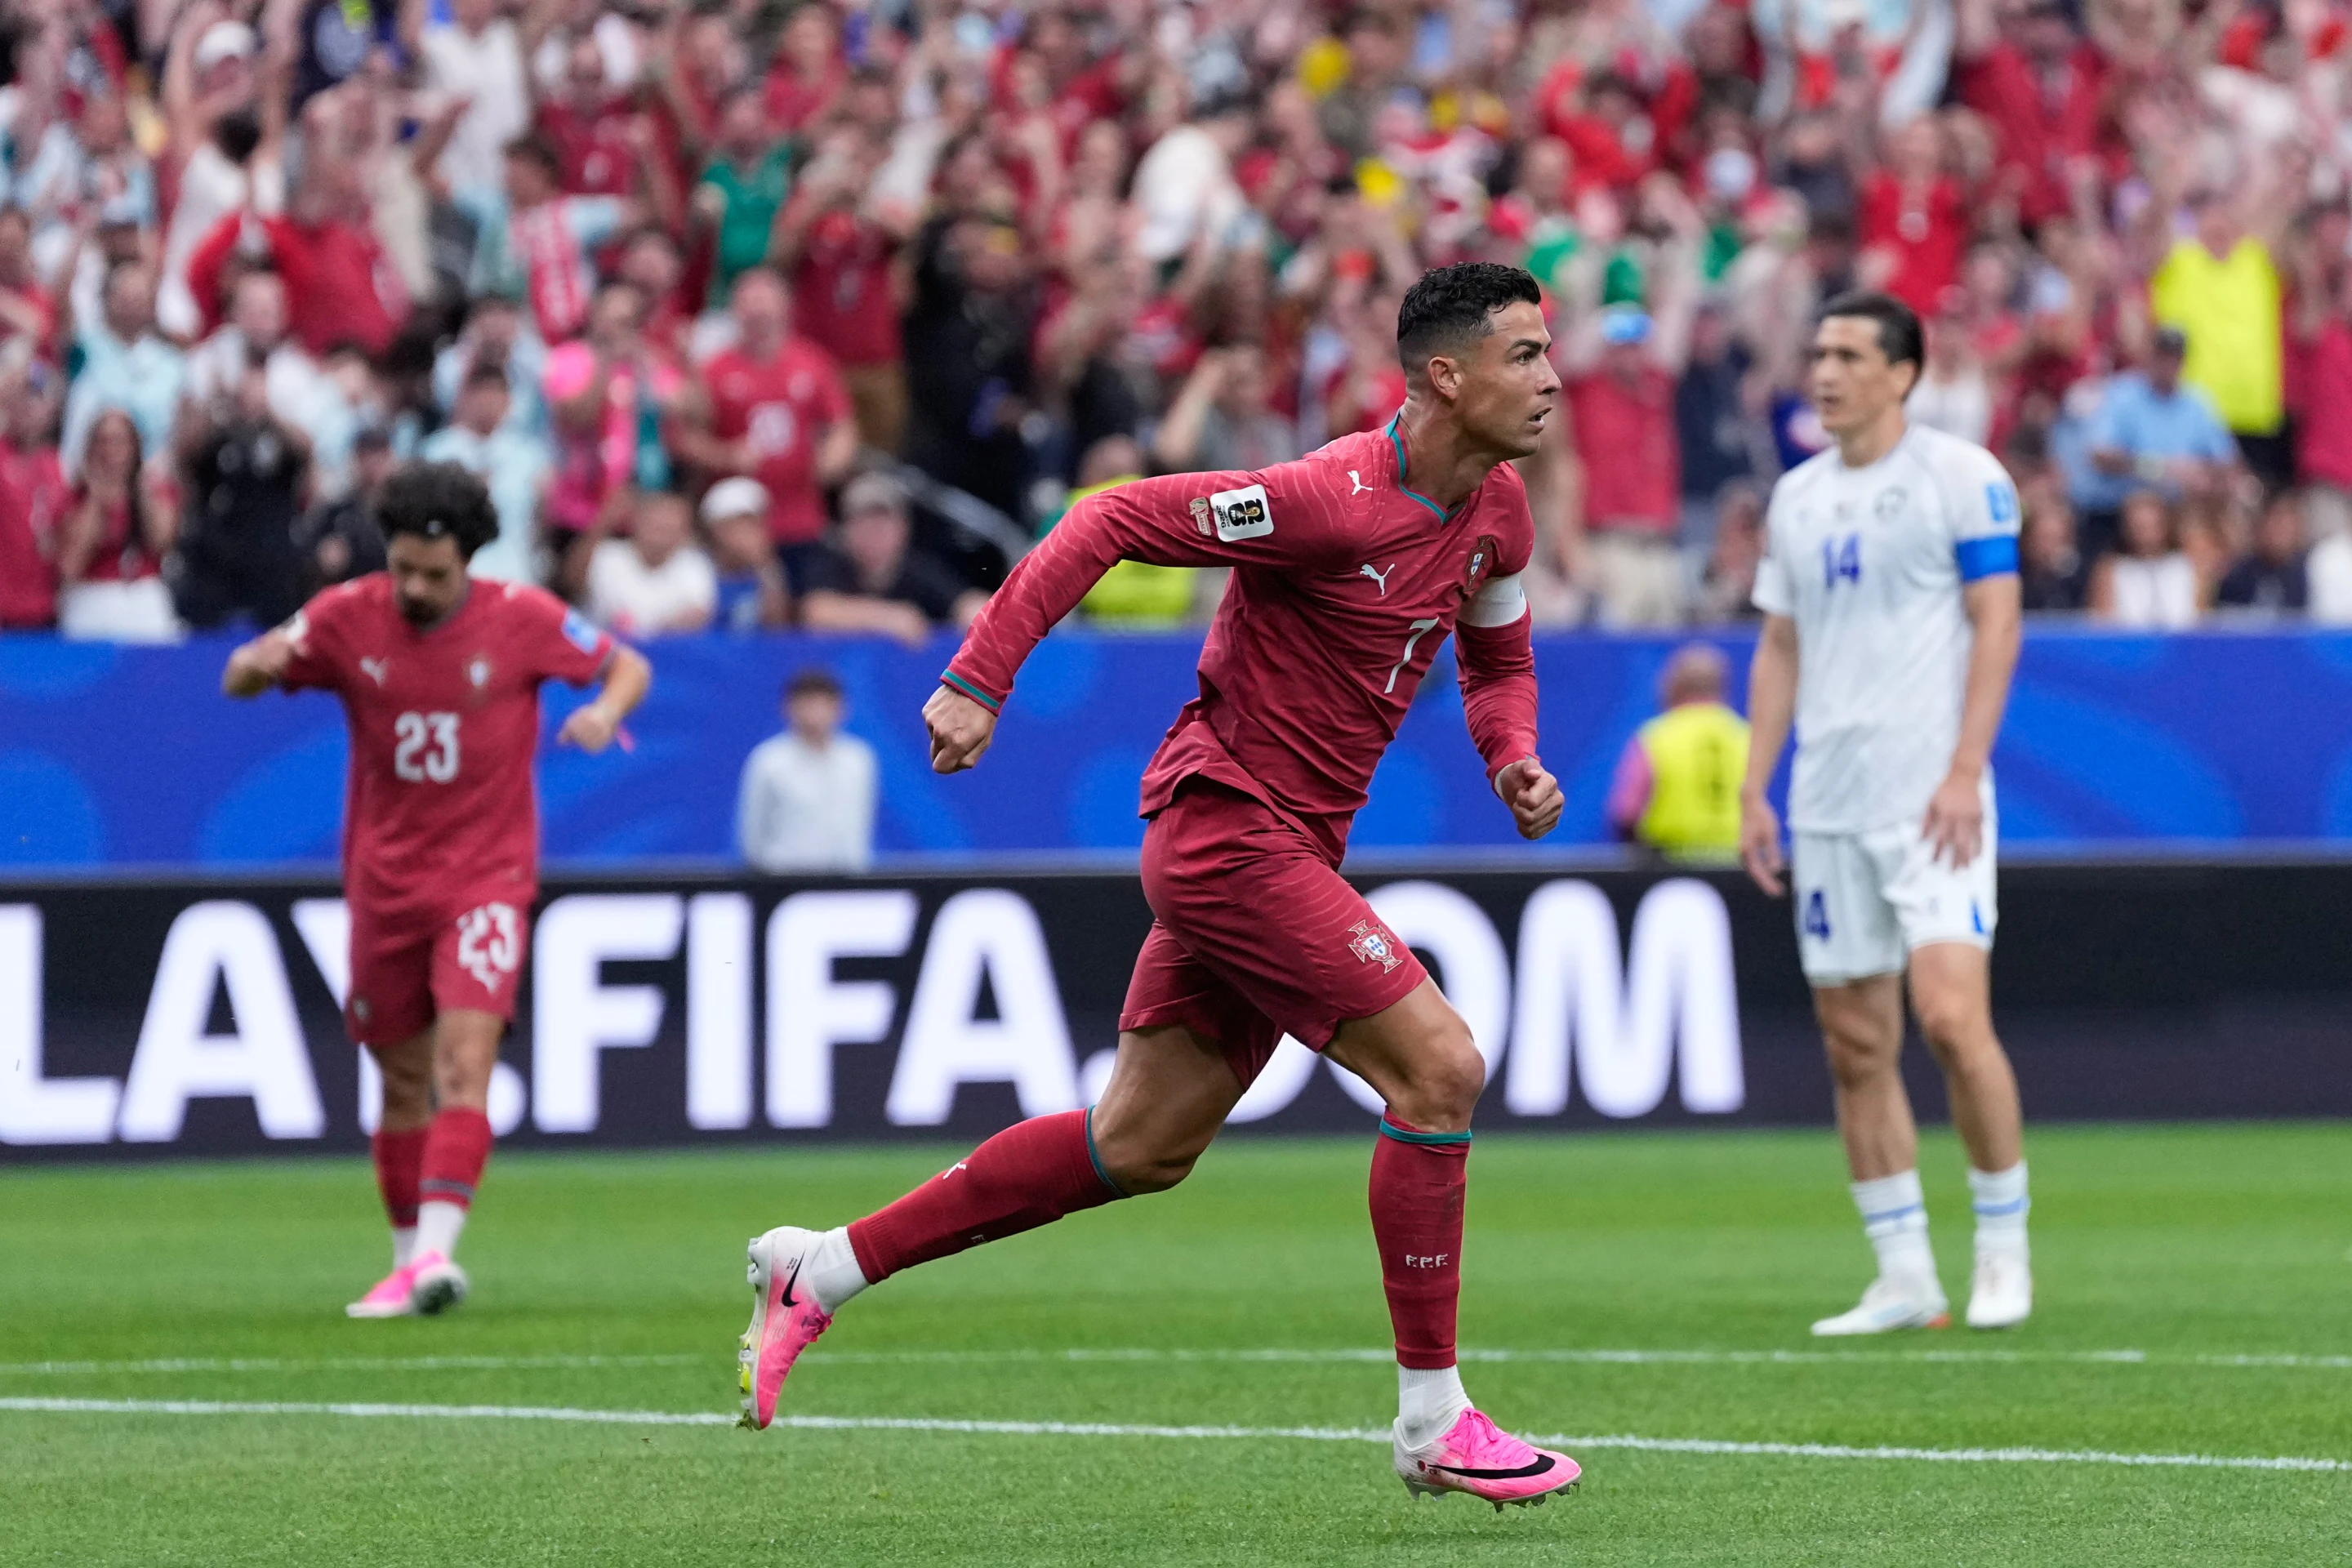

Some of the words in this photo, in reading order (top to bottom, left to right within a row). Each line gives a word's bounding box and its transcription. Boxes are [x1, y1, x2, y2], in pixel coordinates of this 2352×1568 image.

[1216, 505, 1227, 528] 2026
[1822, 531, 1862, 590] 14
[1384, 617, 1439, 693] 7
[394, 711, 461, 784] 23
[457, 901, 517, 973] 23
